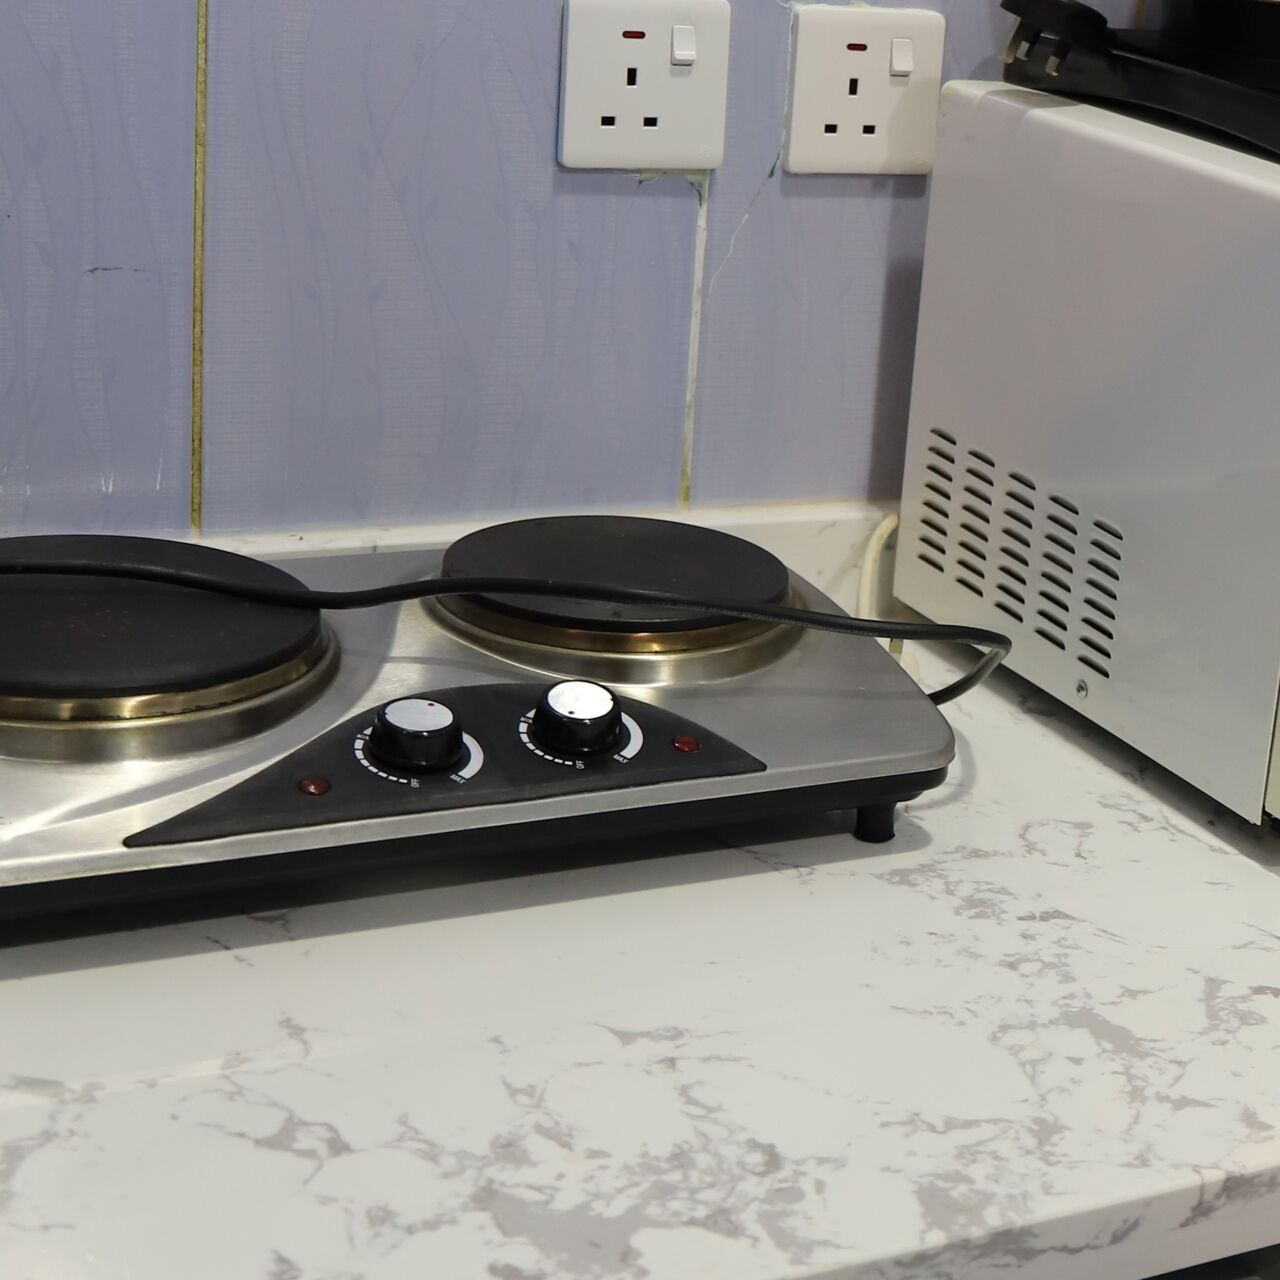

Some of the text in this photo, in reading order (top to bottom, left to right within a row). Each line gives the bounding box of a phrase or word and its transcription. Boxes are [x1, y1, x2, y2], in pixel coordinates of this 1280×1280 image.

[612, 753, 629, 764] MAX
[575, 760, 585, 770] OFF
[410, 778, 420, 788] OFF
[449, 773, 467, 784] MAX
